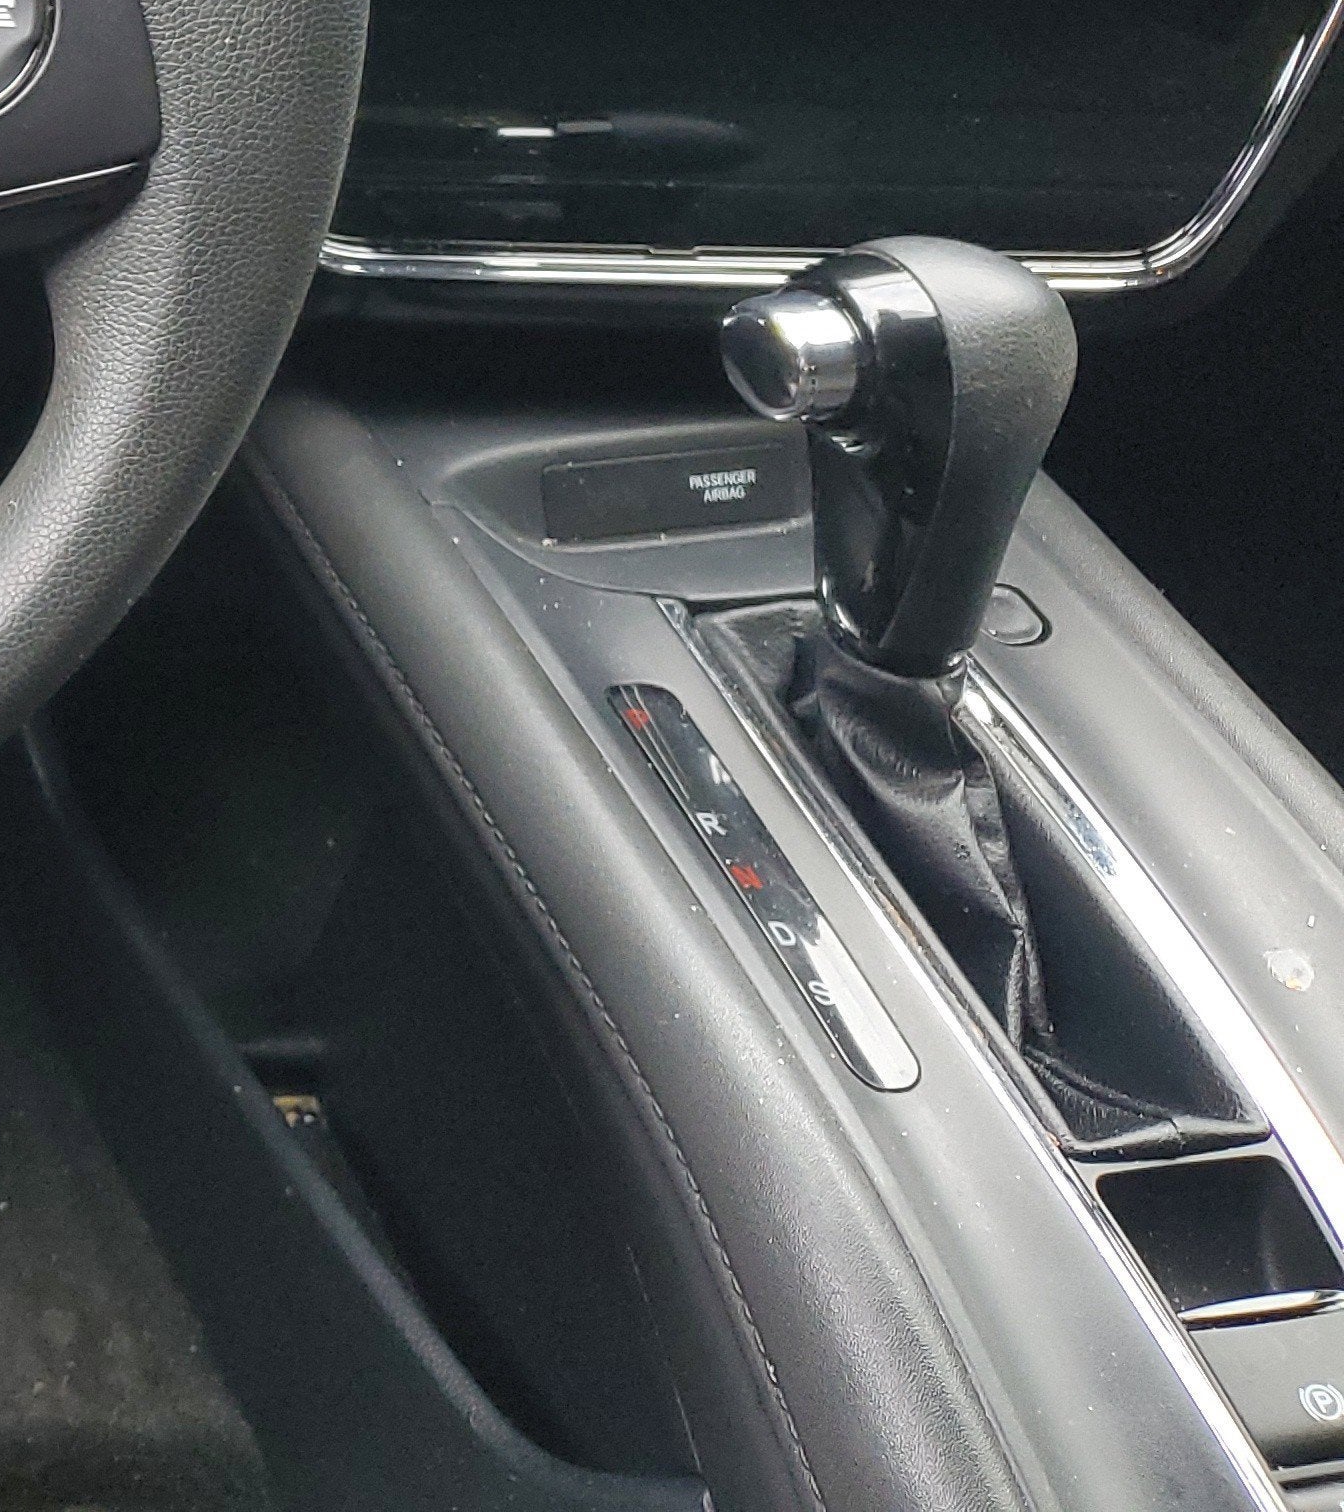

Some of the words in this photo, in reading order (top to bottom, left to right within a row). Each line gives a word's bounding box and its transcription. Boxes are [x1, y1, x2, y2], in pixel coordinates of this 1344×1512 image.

[688, 468, 757, 489] PASSENGER
[703, 486, 746, 503] AIRBAG
[696, 812, 727, 836] R
[768, 921, 796, 946] D
